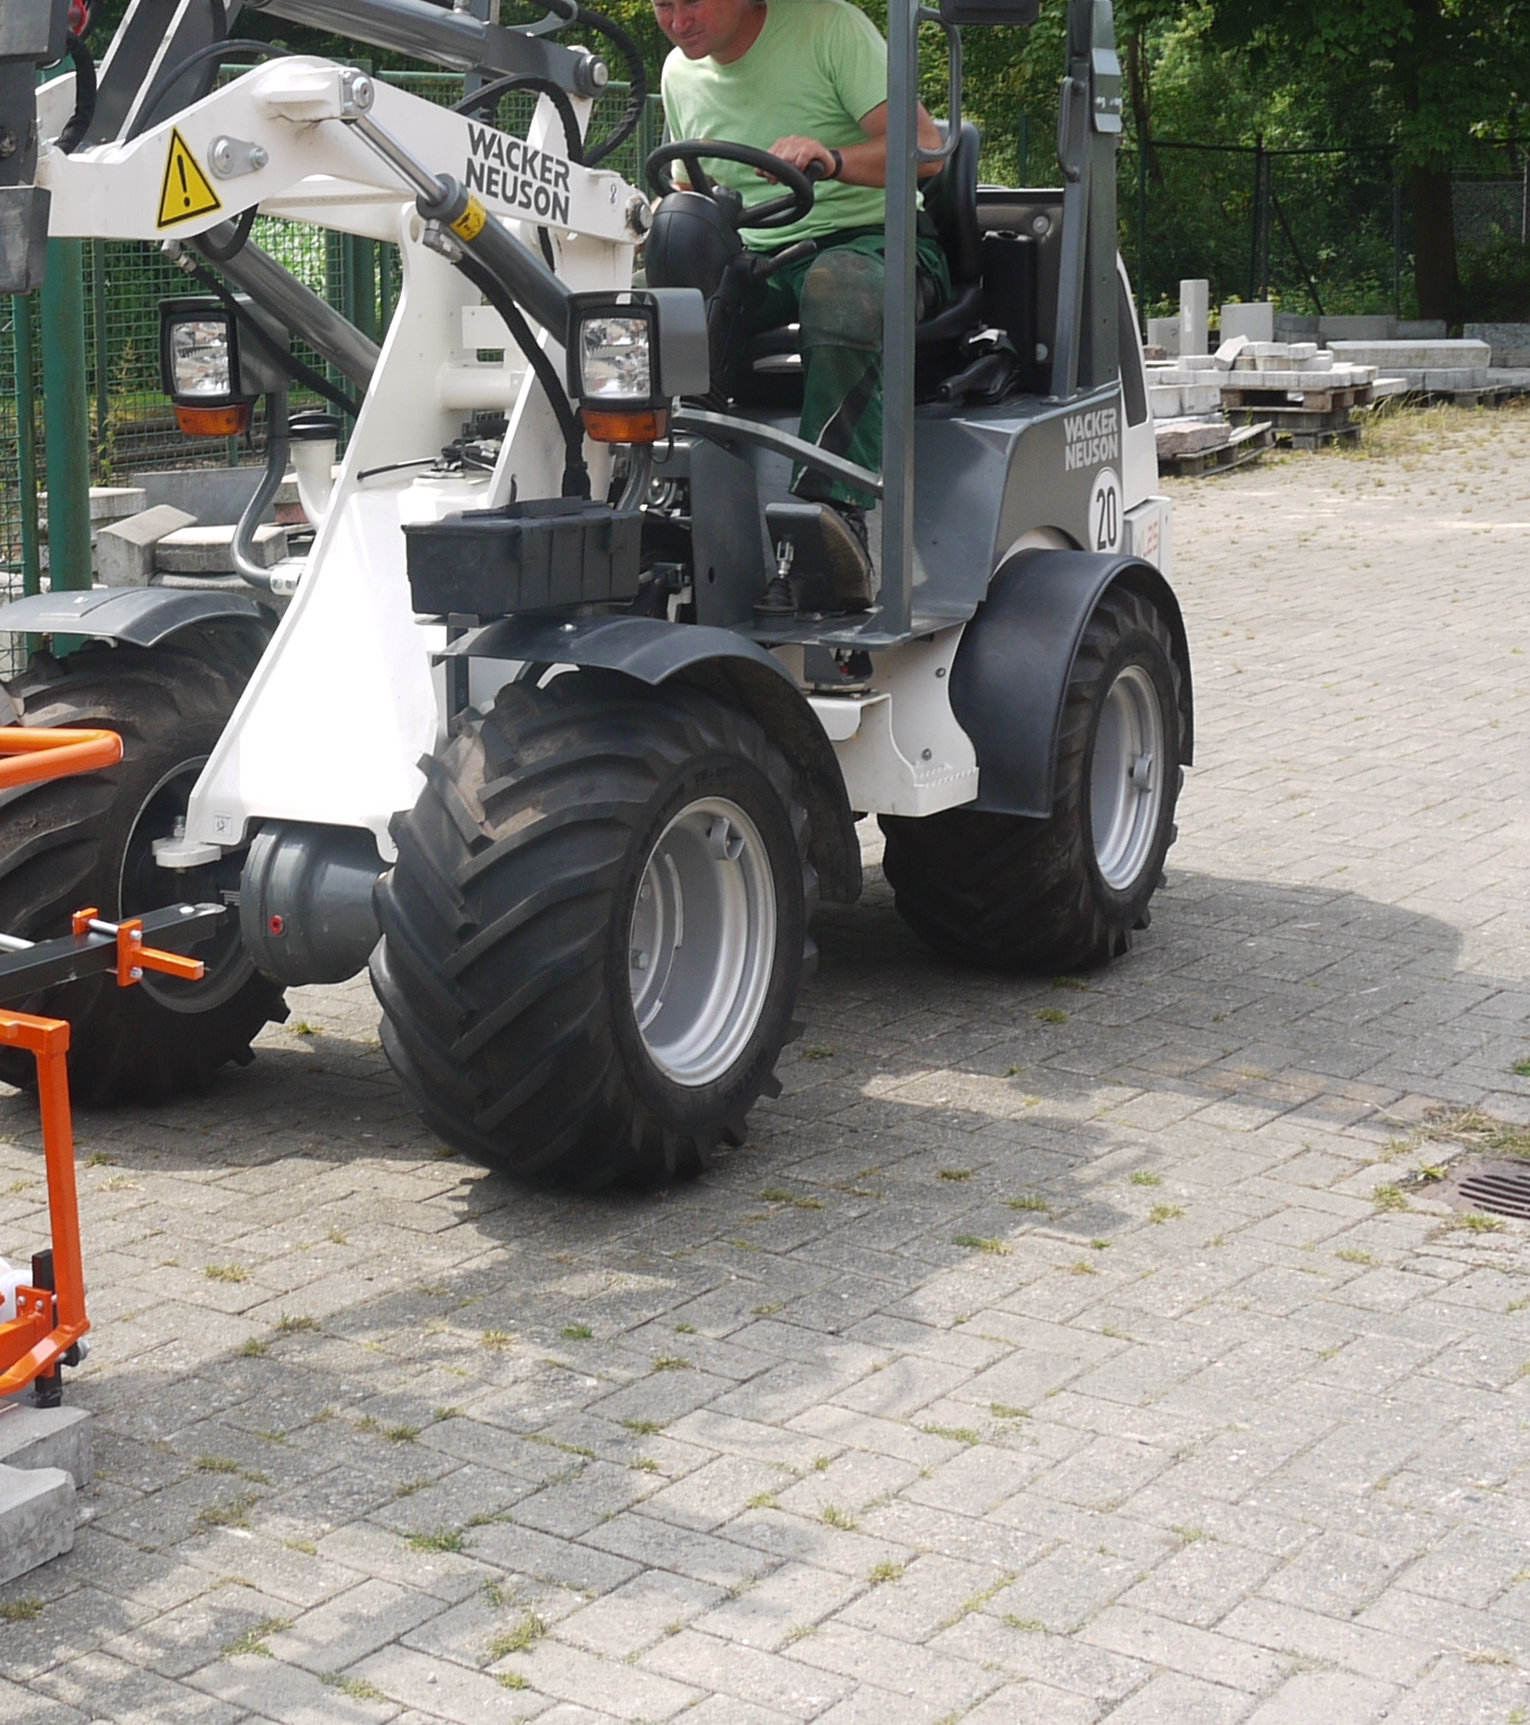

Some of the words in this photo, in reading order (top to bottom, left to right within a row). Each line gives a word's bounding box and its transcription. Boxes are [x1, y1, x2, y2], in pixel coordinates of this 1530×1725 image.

[468, 122, 571, 192] WACKER
[465, 157, 570, 225] NEUSON
[1063, 407, 1118, 443] WACKER
[1065, 433, 1119, 471] NEUSON
[1096, 485, 1117, 551] 20
